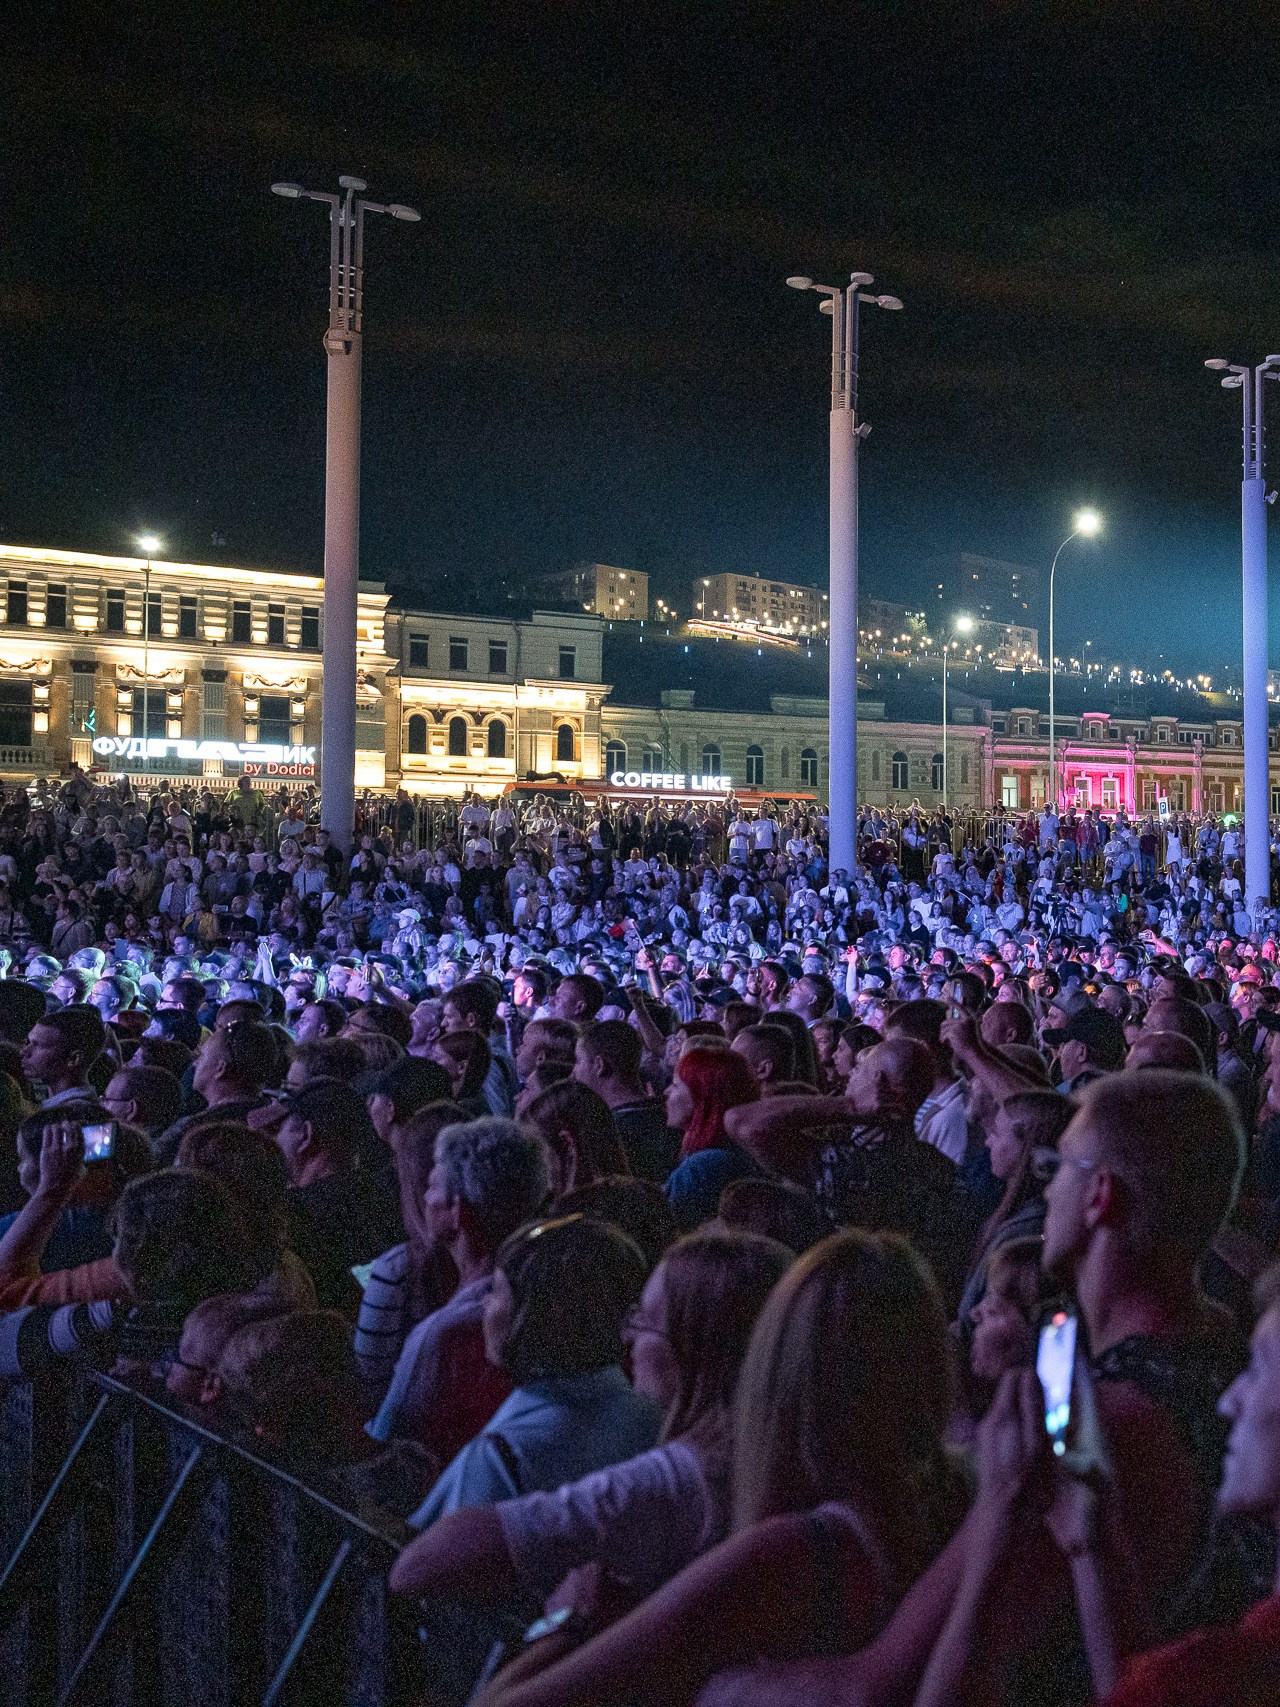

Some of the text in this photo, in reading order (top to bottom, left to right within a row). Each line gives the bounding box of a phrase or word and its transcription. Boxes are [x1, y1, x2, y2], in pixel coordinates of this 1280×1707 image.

[243, 761, 315, 777] by Dodici
[610, 771, 732, 791] COFFEE LIKE
